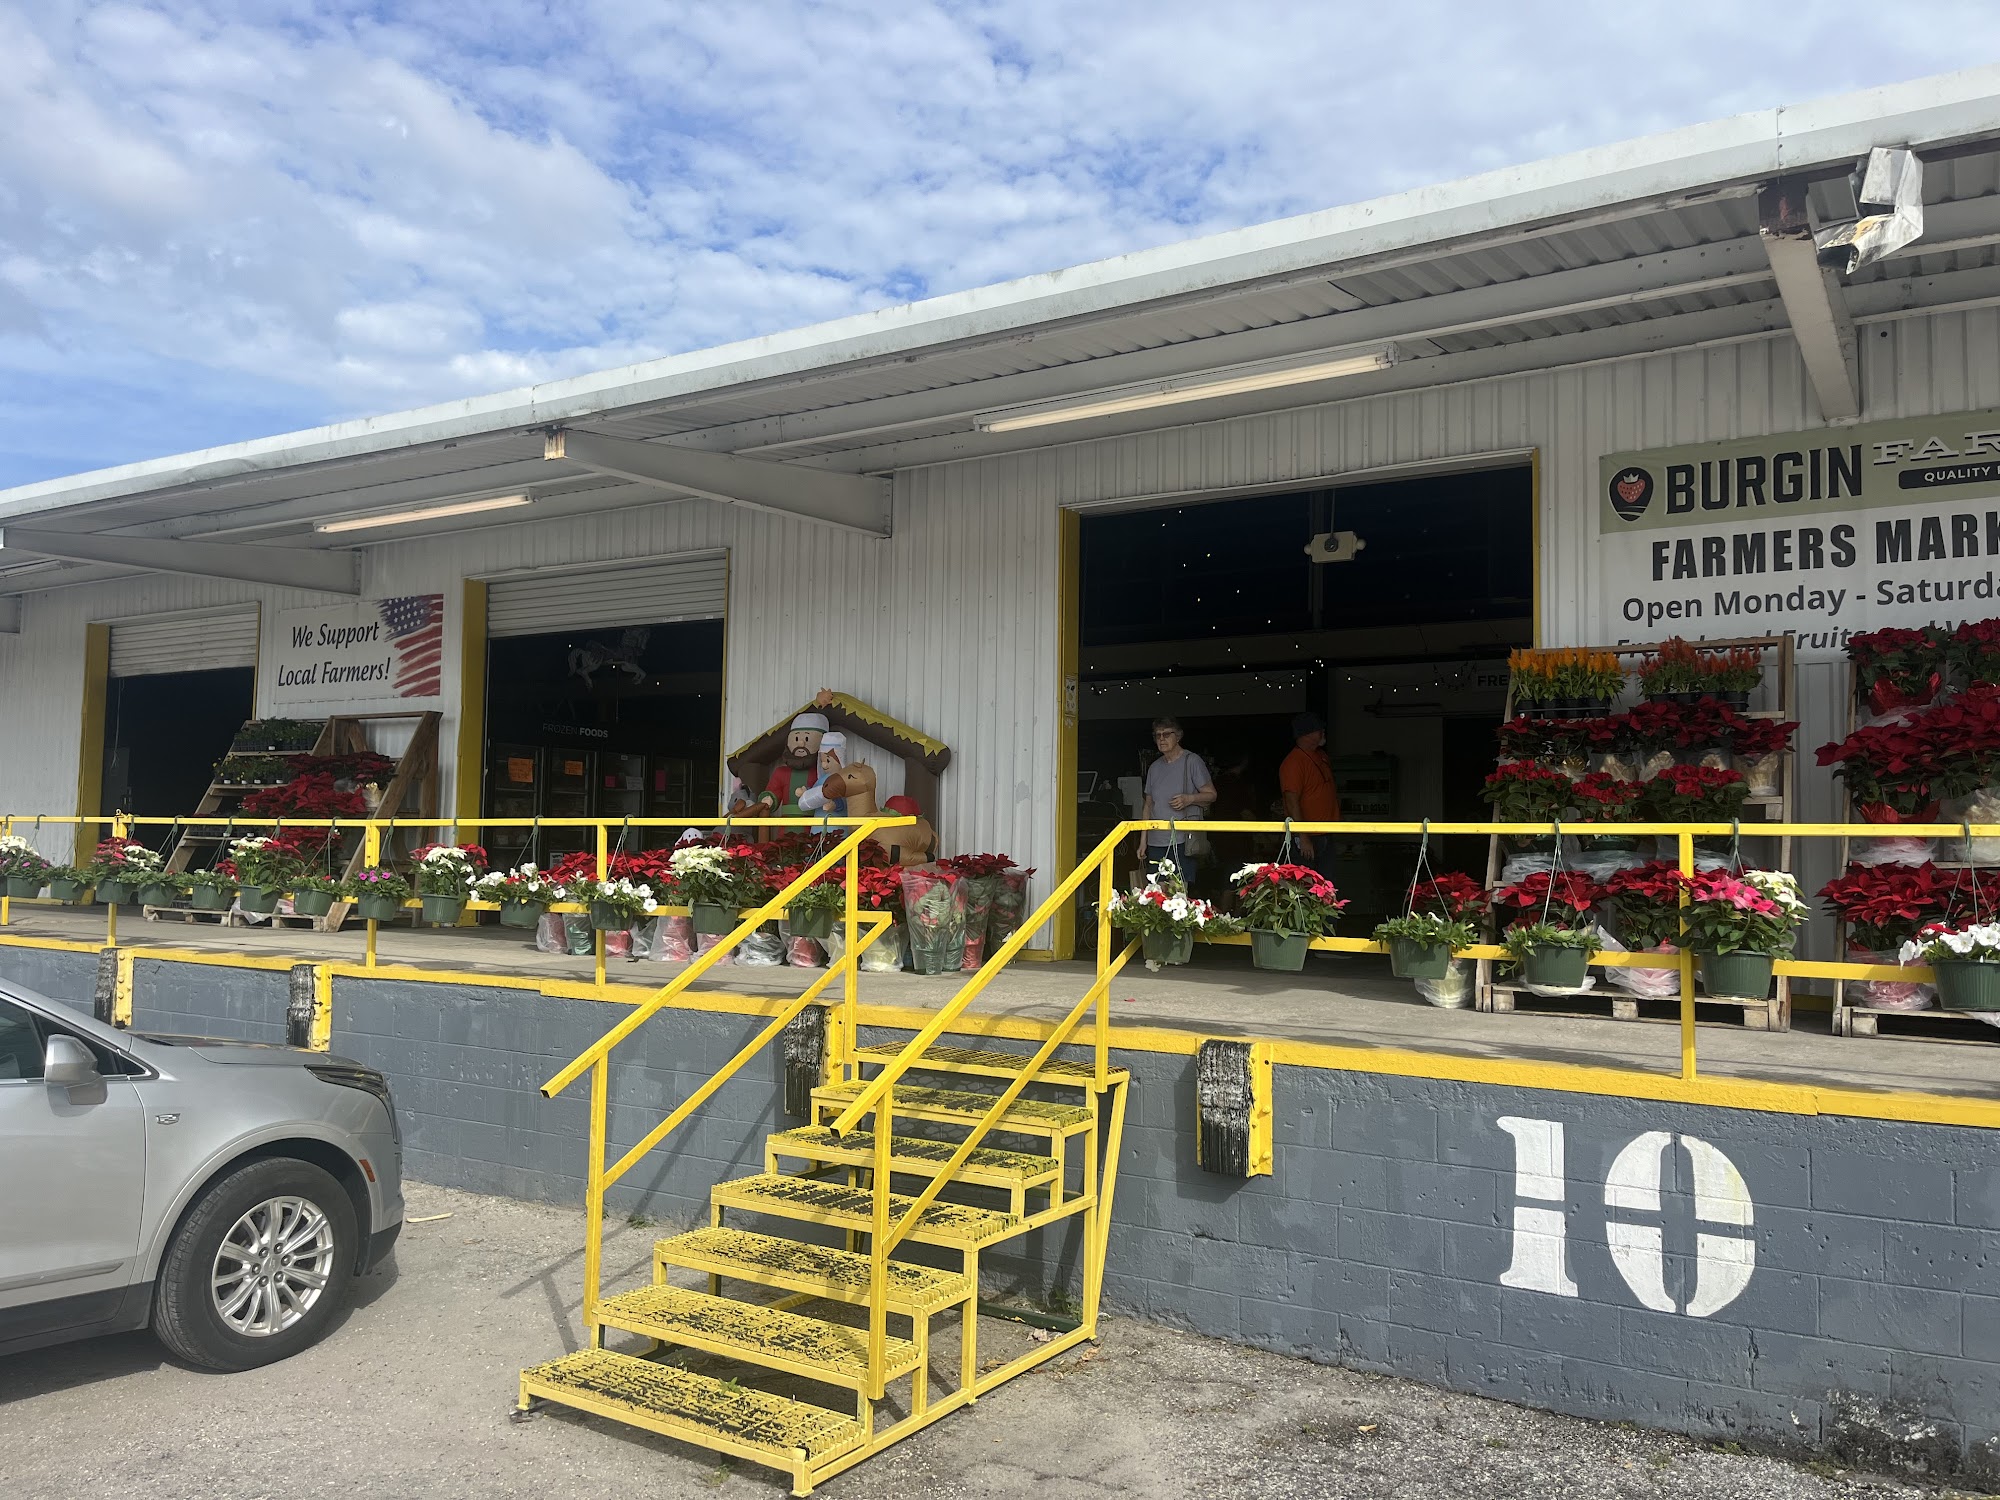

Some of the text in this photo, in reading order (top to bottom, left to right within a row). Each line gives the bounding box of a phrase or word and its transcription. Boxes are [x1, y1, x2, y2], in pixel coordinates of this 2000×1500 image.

[1665, 443, 1863, 515] BURGIN
[1924, 466, 1991, 483] QUALITY
[1652, 524, 1857, 582] FARMERS
[1623, 597, 1702, 628] Open
[1714, 585, 1846, 616] Monday
[1877, 571, 2000, 605] Saturd
[292, 621, 380, 650] We Support
[278, 657, 391, 687] Local Farmers!
[542, 723, 609, 738] FROZEN FOODS
[1497, 1115, 1756, 1317] 10
